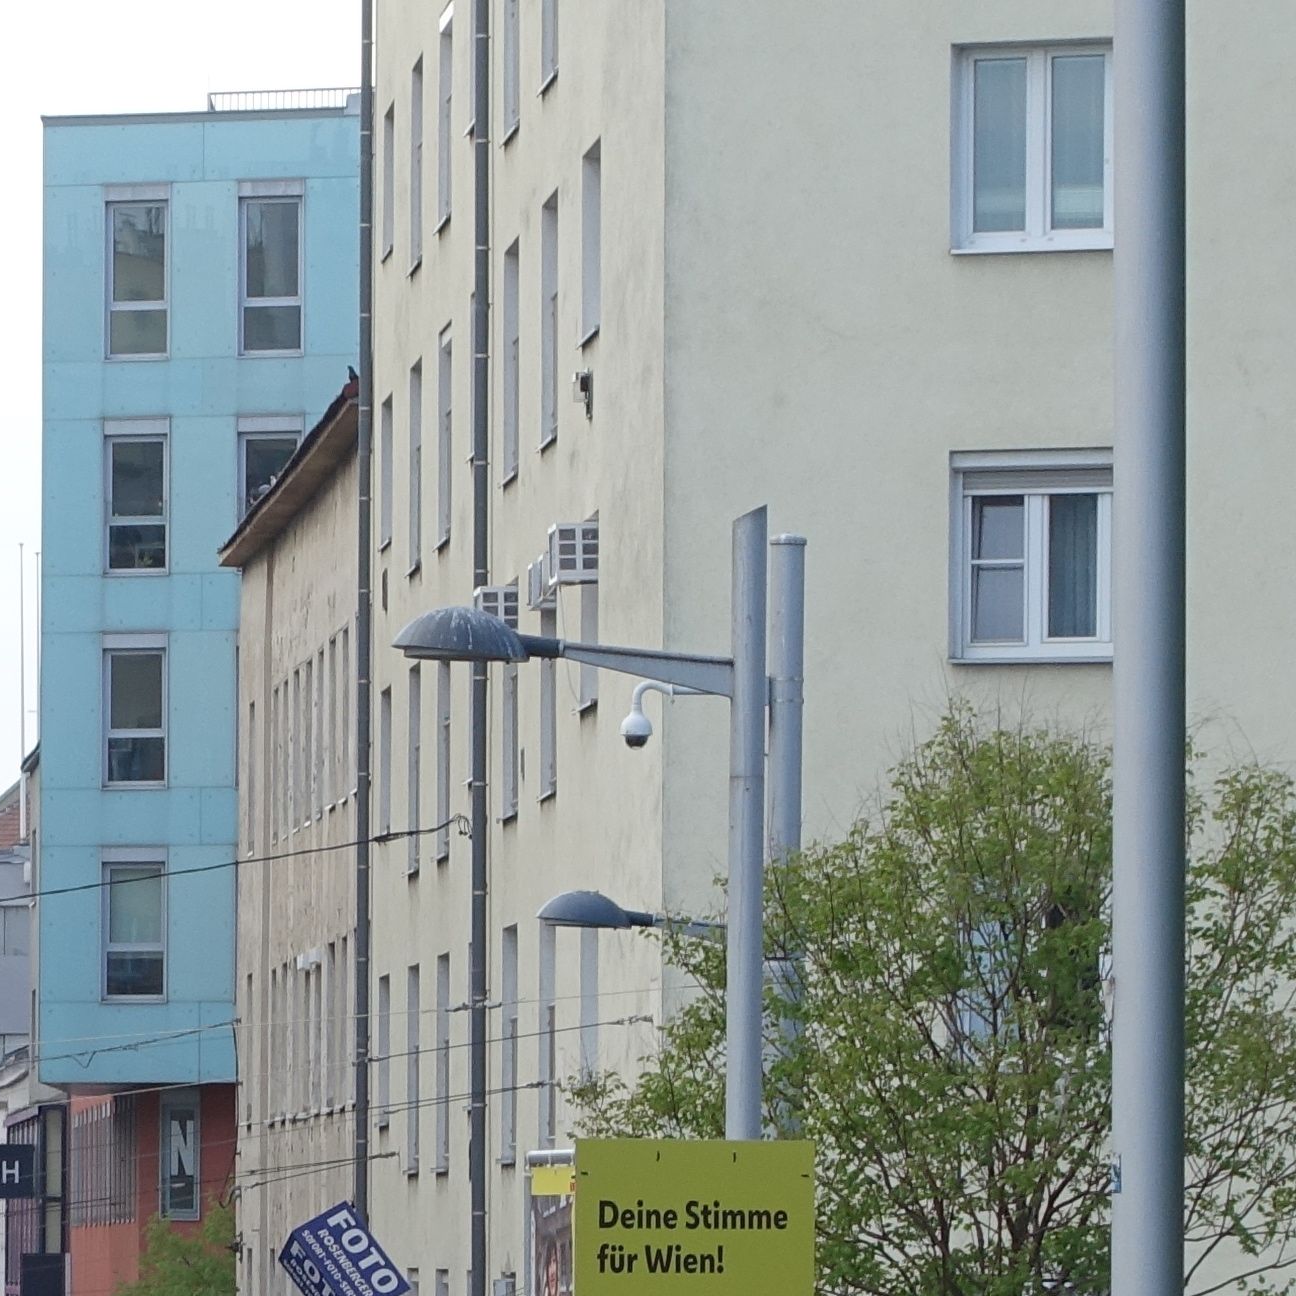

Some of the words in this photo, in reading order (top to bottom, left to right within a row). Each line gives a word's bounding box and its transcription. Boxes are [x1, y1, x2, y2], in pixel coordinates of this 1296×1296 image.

[598, 1199, 678, 1230] Deine
[685, 1199, 788, 1230] Stimme
[326, 1209, 399, 1294] FOTO
[597, 1243, 638, 1274] für
[644, 1244, 724, 1274] Wien!
